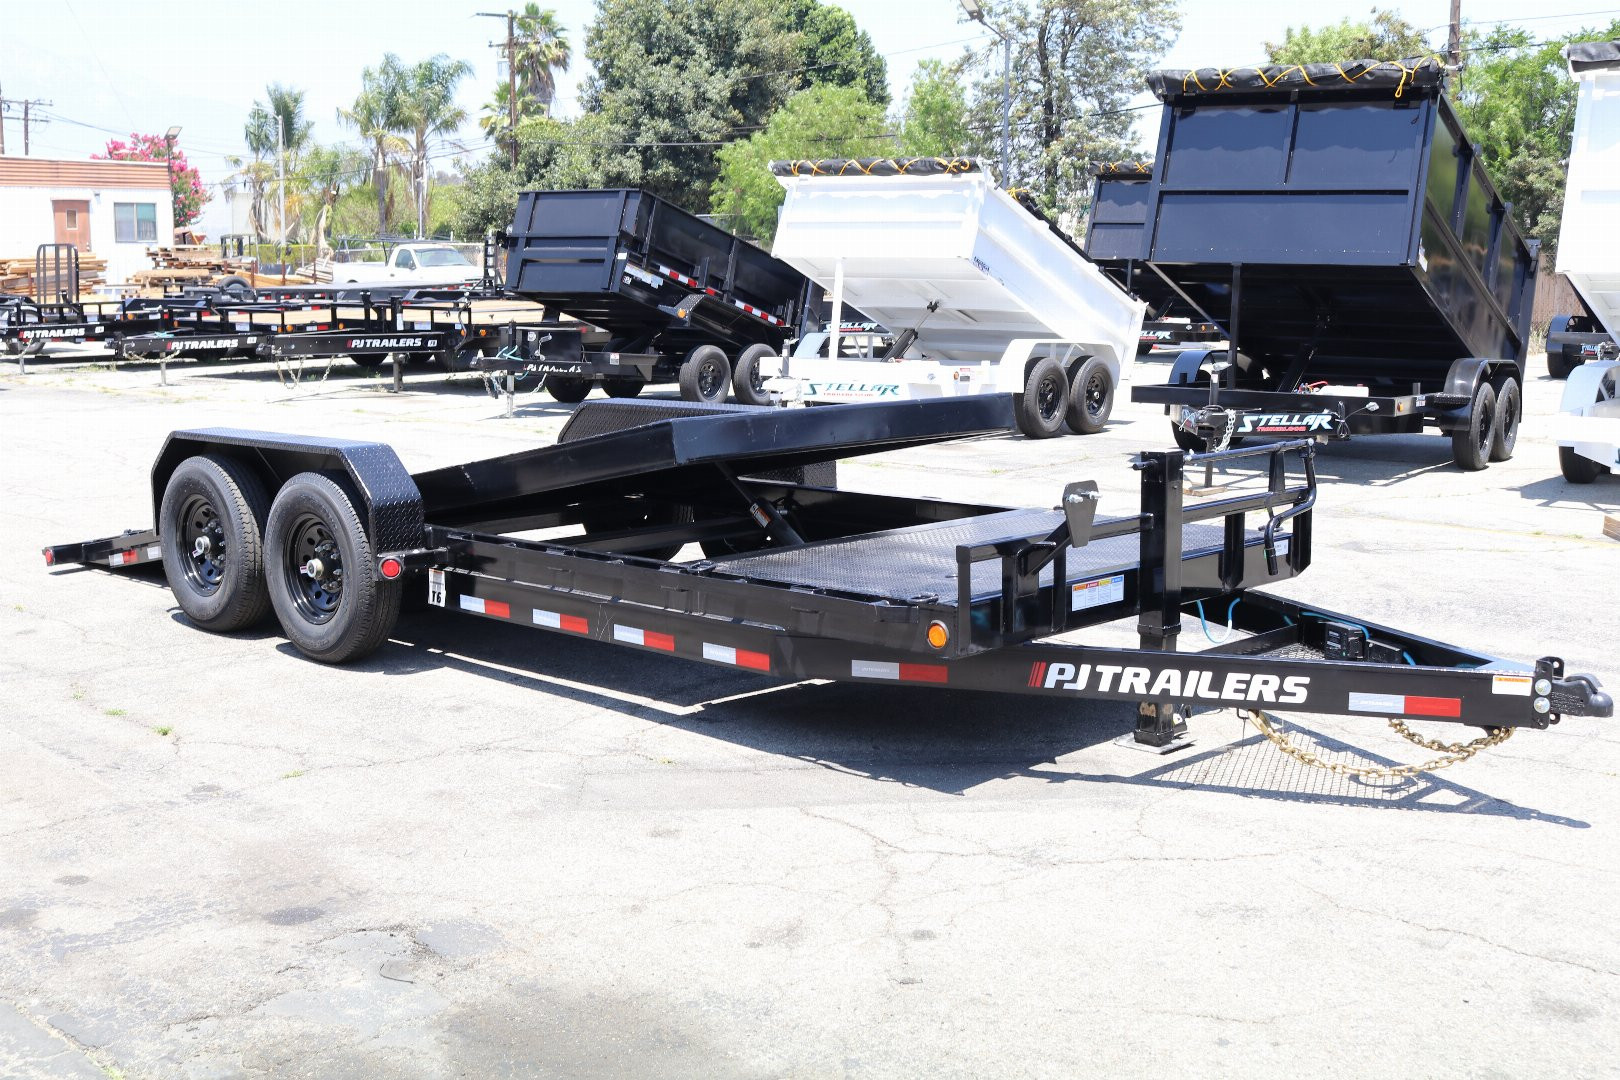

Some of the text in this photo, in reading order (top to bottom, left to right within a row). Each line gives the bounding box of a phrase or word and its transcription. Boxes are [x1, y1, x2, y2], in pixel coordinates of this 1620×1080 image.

[35, 328, 85, 339] TRAILERS
[185, 339, 239, 350] TRAILERS
[351, 339, 364, 348] PJ
[365, 338, 422, 348] TRAILERS
[803, 383, 899, 396] STELLAR
[1237, 414, 1334, 433] STELLAR
[432, 590, 442, 604] T6
[1044, 662, 1311, 704] PJ TRAILERS
